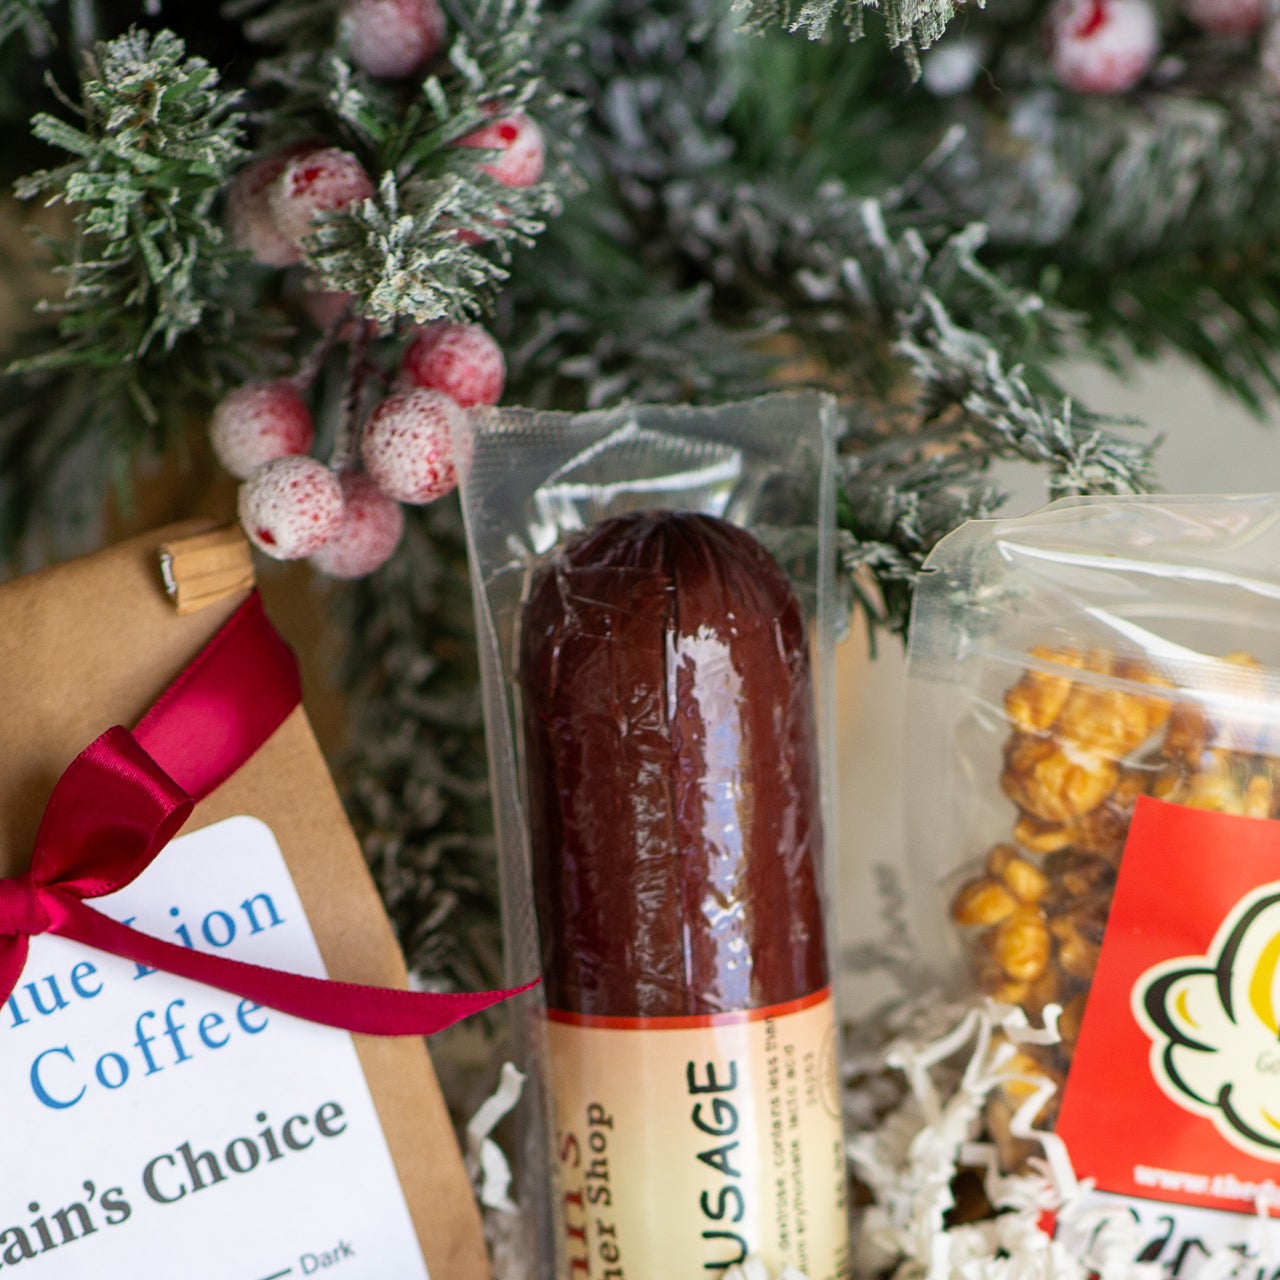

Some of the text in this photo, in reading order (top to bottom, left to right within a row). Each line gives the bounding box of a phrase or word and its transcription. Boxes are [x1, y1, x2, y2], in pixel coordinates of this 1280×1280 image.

[28, 997, 271, 1112] Coffee
[143, 1099, 350, 1206] Choice
[586, 1101, 614, 1207] Shop
[299, 1237, 357, 1278] Dark
